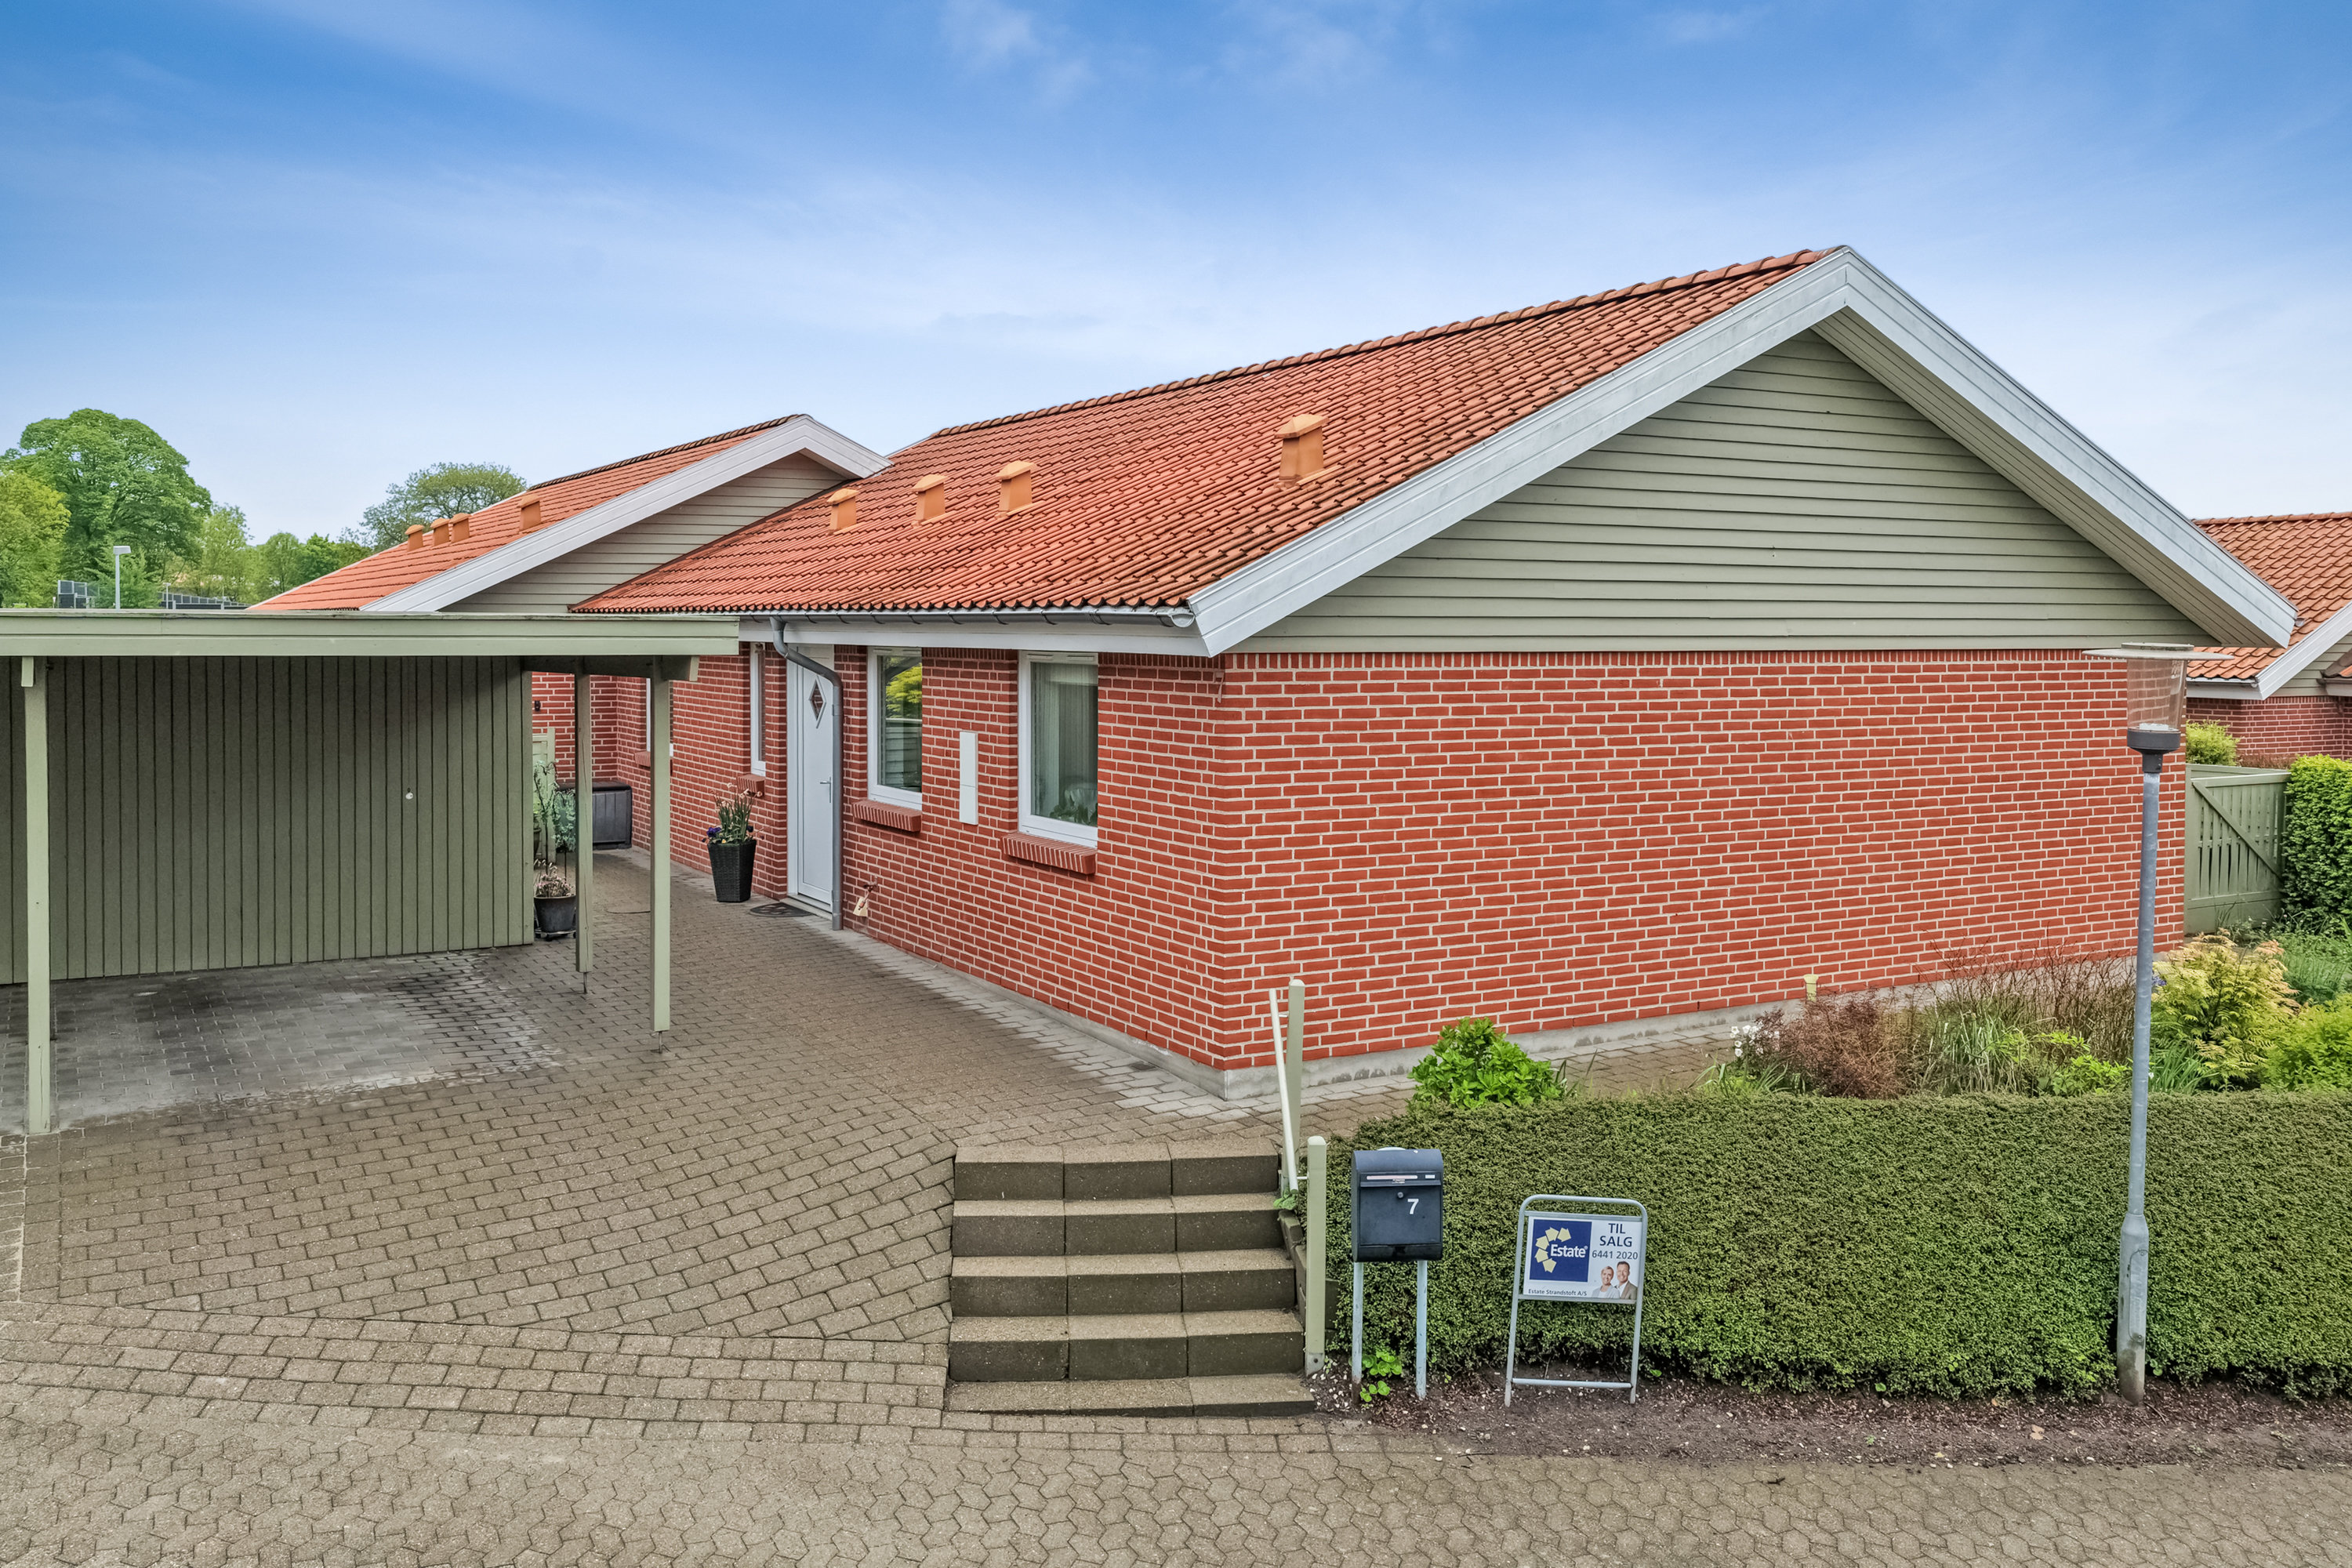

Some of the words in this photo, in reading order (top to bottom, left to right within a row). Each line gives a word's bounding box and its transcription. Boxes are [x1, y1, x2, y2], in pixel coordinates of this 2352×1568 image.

[1407, 1199, 1419, 1214] 7
[1608, 1223, 1625, 1234] TIL
[1599, 1236, 1632, 1247] SALG
[1551, 1244, 1586, 1258] Estate
[1592, 1250, 1613, 1258] 6441
[1616, 1251, 1638, 1260] 2020
